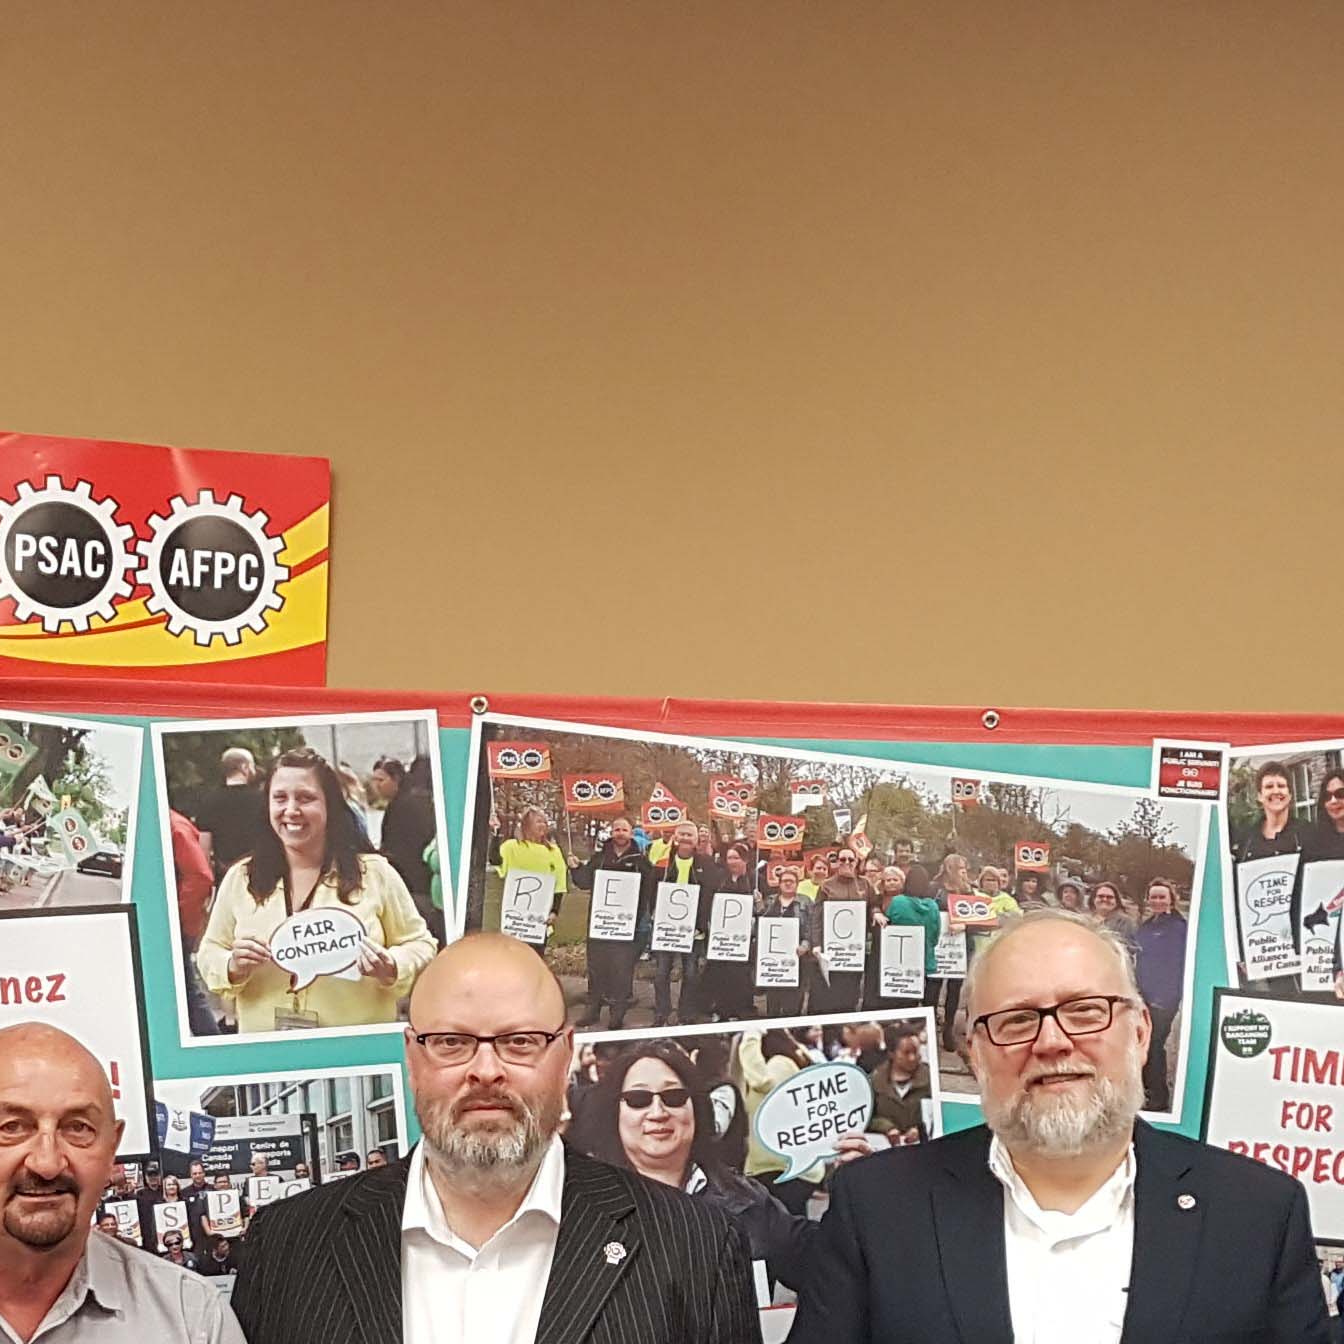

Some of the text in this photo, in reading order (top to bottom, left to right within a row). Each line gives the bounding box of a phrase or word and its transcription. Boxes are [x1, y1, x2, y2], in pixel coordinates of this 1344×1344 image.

[14, 533, 259, 592] PSAC AFPC
[514, 876, 543, 910] R
[605, 879, 622, 907] E
[1259, 876, 1288, 889] TIME
[668, 889, 689, 921] S
[723, 899, 743, 929] P
[1254, 894, 1292, 908] RESPEC
[292, 920, 336, 941] FAIR
[833, 909, 854, 940] C
[276, 931, 362, 961] CONTRACT!
[769, 924, 787, 954] E
[888, 934, 913, 965] T
[1249, 936, 1278, 947] Public
[1252, 953, 1289, 963] Alliance
[1307, 966, 1334, 974] Allian
[787, 1072, 849, 1107] TIME
[807, 1101, 839, 1121] FOR
[1281, 1101, 1334, 1132] FOR
[777, 1104, 868, 1150] RESPECT
[216, 1194, 232, 1214] P
[257, 1180, 273, 1200] E
[114, 1204, 131, 1225] E
[163, 1207, 179, 1228] S
